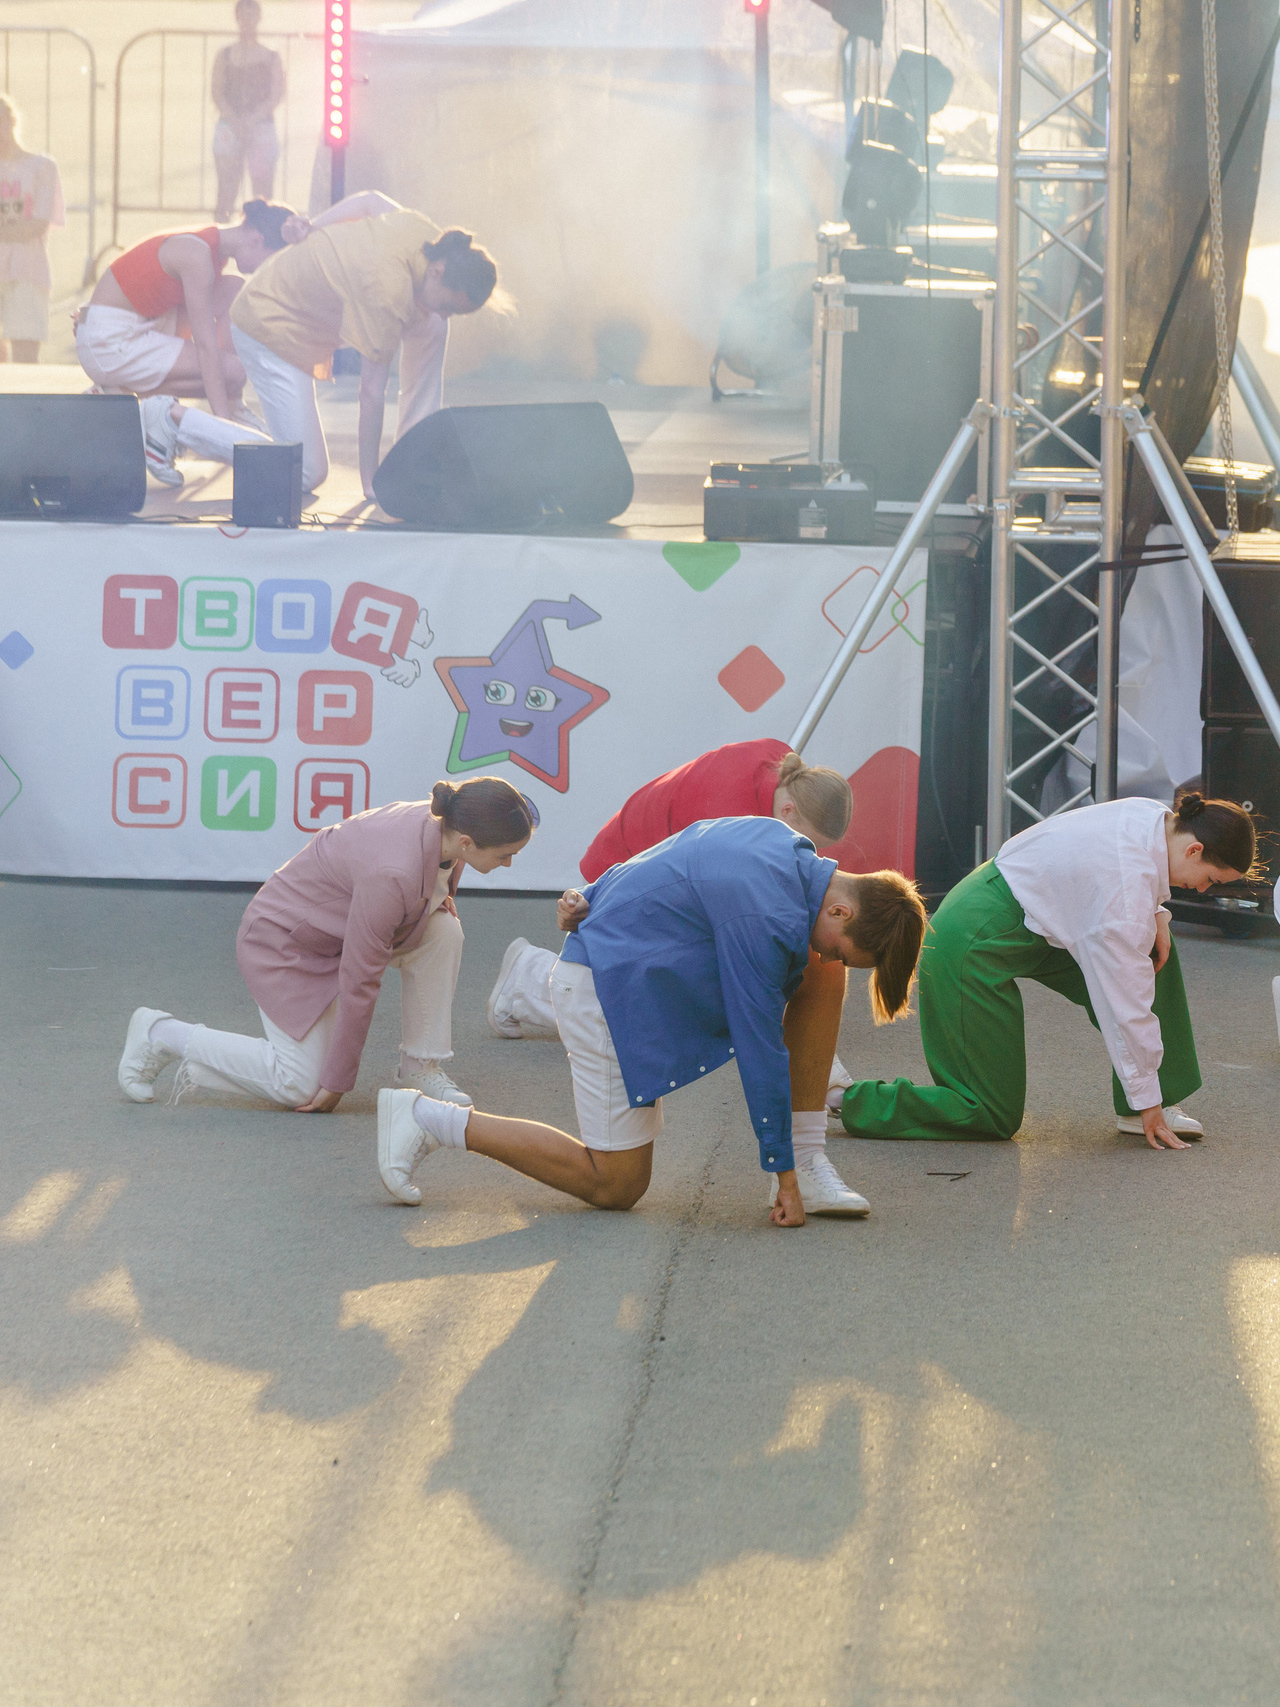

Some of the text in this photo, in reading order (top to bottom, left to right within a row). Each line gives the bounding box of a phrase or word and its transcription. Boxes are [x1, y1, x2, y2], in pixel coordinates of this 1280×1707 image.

[119, 587, 403, 654] ТВОЯ
[130, 678, 358, 732] ВЕР
[127, 766, 354, 820] СИЯ
